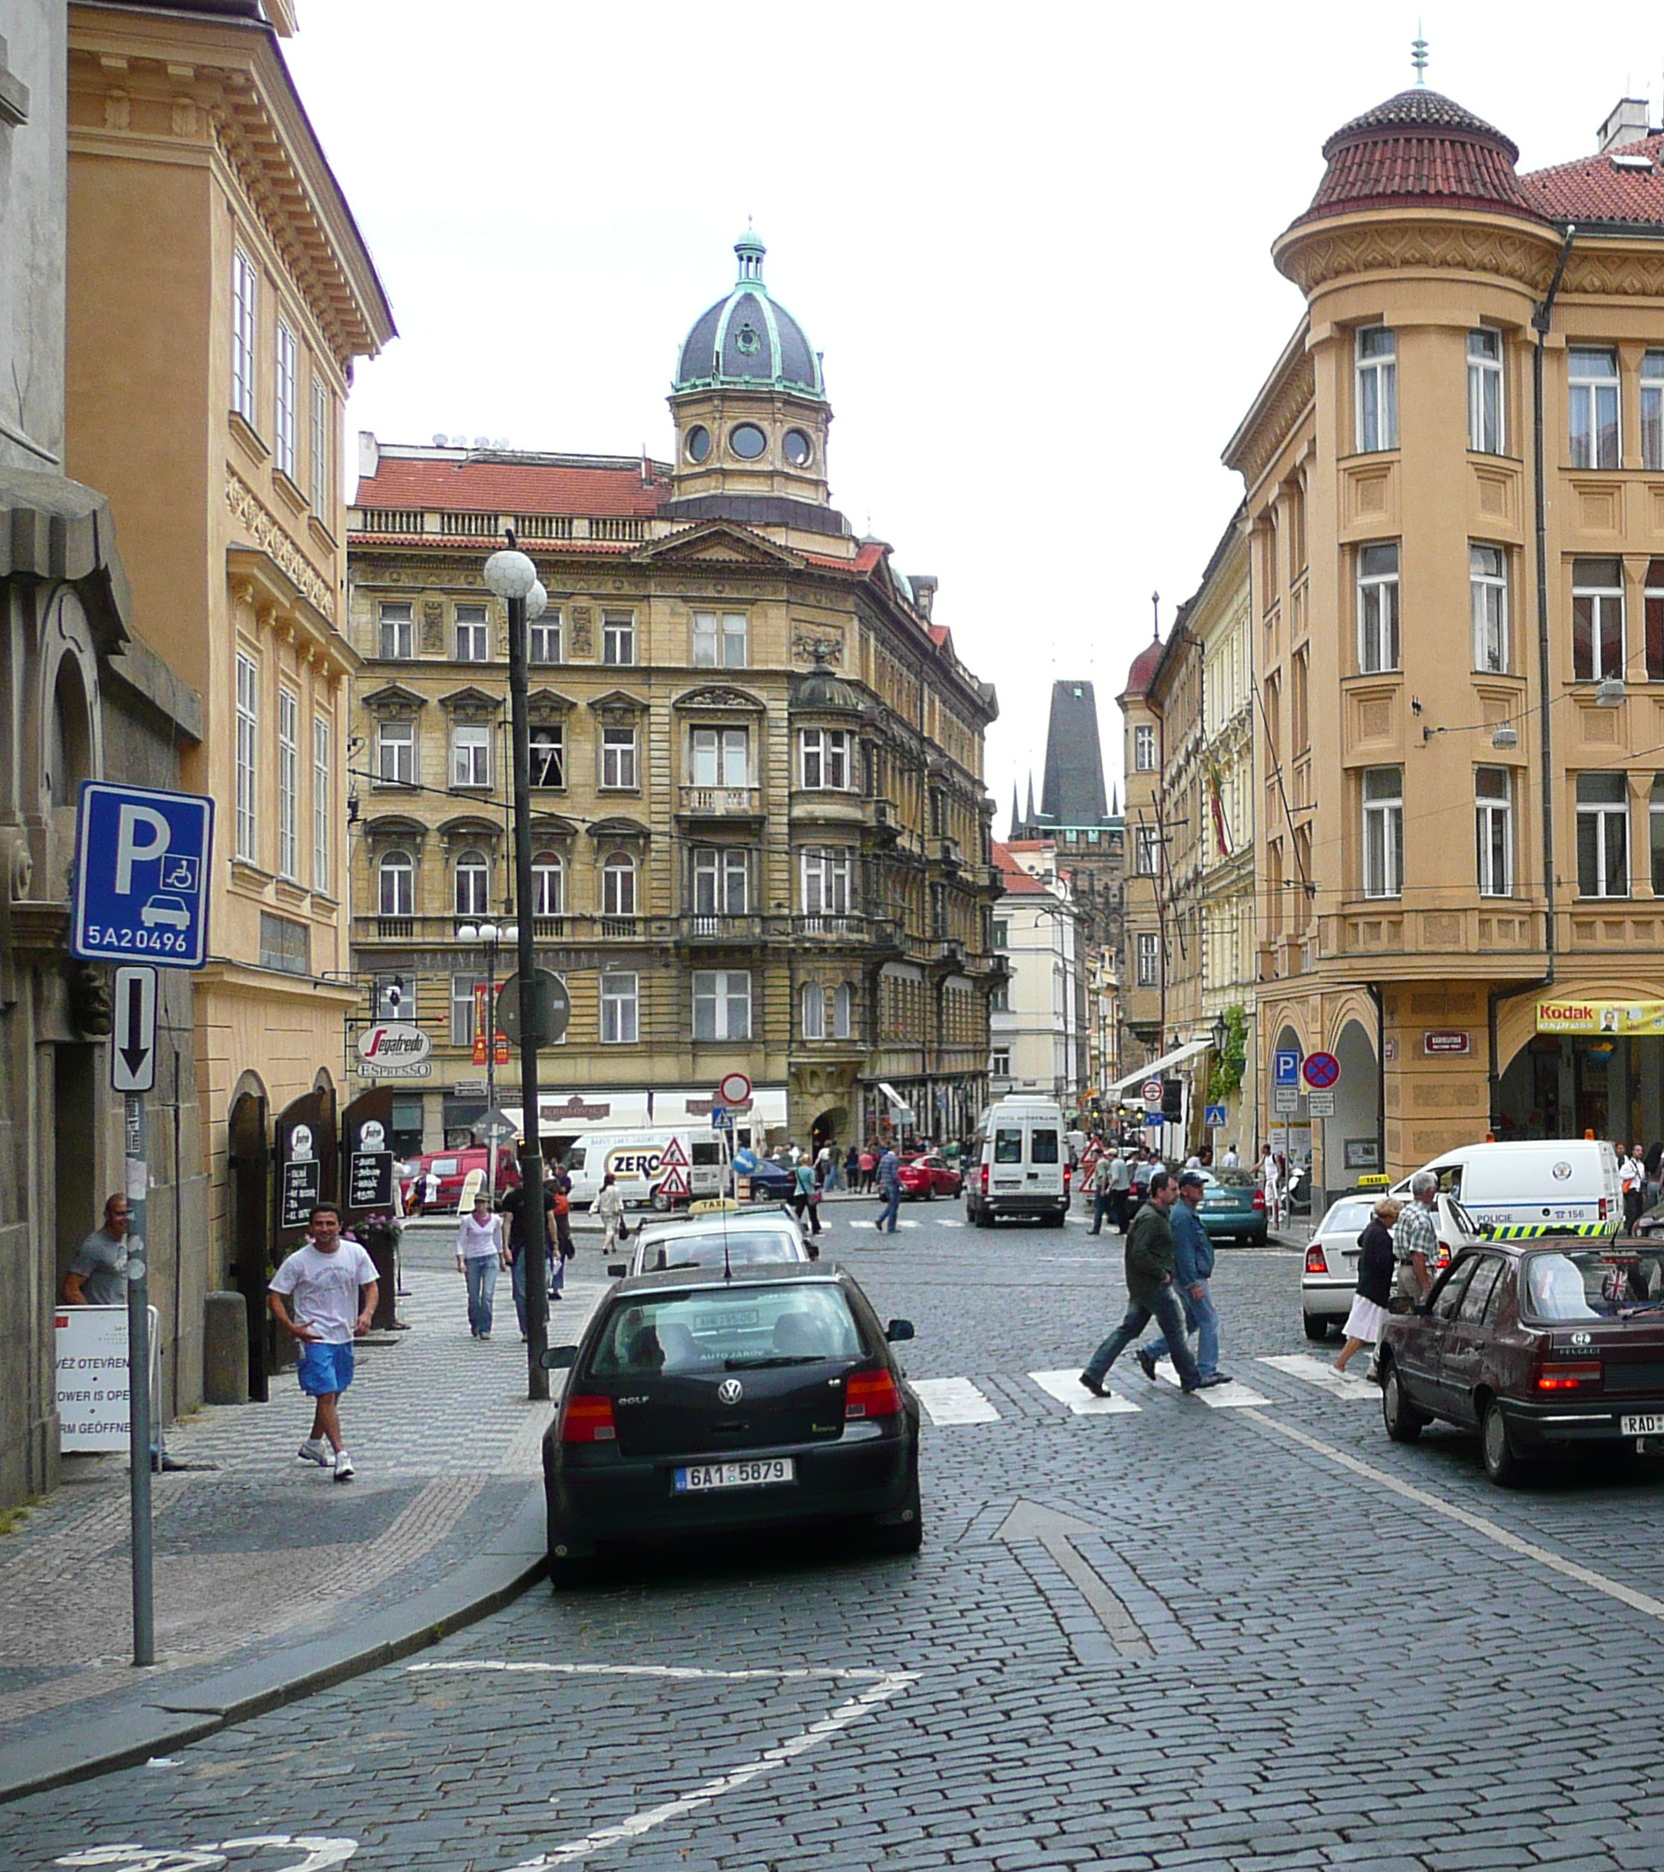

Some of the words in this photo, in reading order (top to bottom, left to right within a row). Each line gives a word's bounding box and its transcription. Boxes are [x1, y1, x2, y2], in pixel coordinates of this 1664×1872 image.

[115, 803, 171, 895] P
[88, 925, 187, 952] 5A20496
[1540, 1005, 1594, 1020] Kodak
[1539, 1021, 1594, 1031] express
[364, 1029, 424, 1057] Segafredo
[361, 1064, 429, 1076] ESPRESSO
[1279, 1056, 1294, 1077] P
[614, 1154, 661, 1179] ZERO
[701, 1200, 726, 1209] TAXI
[1476, 1213, 1514, 1224] POLICIE
[1567, 1209, 1585, 1220] 156
[78, 1357, 130, 1370] OTEVŘEN
[57, 1390, 91, 1402] OWER
[93, 1390, 104, 1401] IS
[107, 1389, 130, 1401] OPE
[60, 1422, 76, 1434] RM
[79, 1420, 131, 1434] GEÖFFNE
[1628, 1417, 1656, 1433] RAD
[690, 1468, 725, 1487] 6A1
[738, 1461, 785, 1483] 5879
